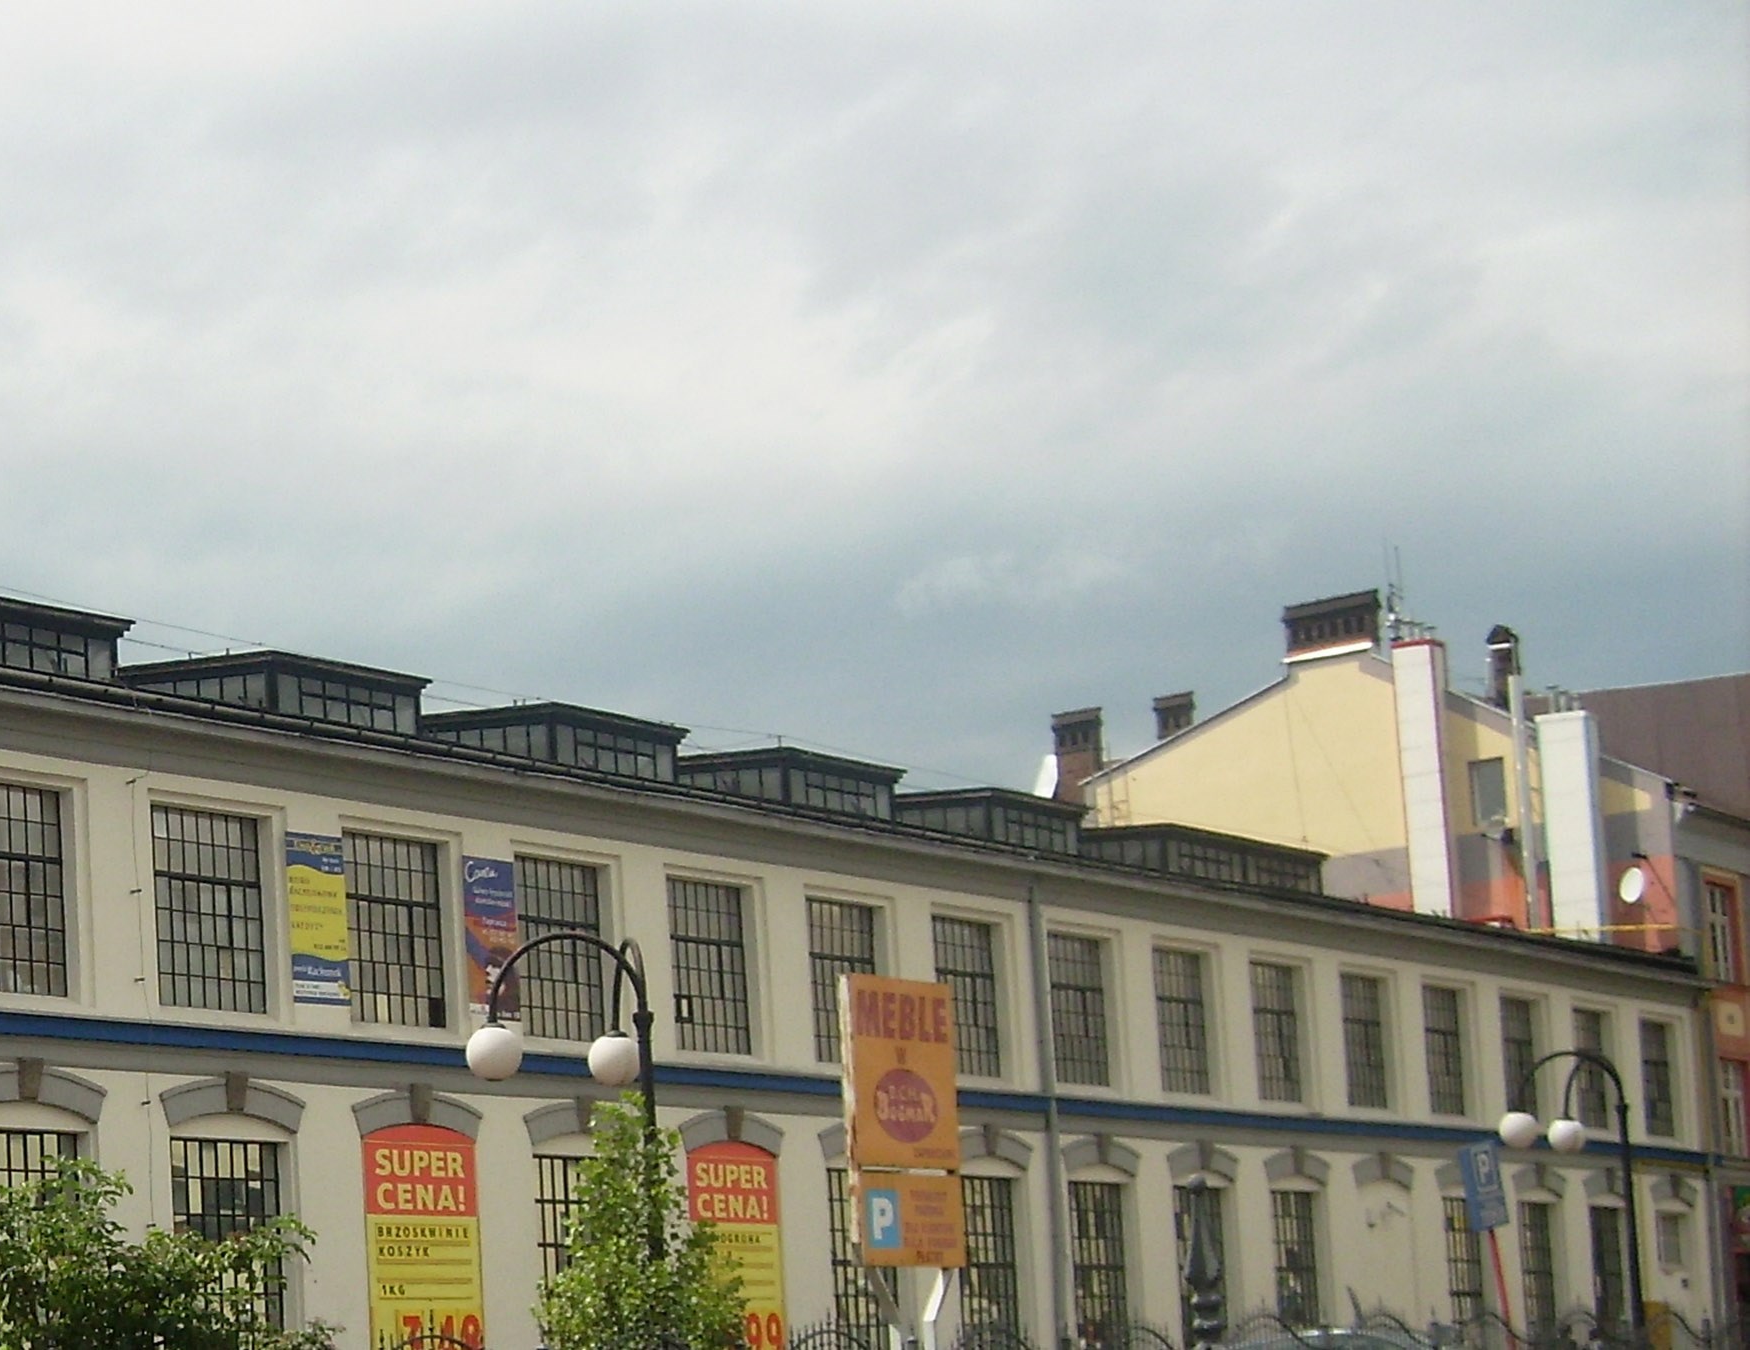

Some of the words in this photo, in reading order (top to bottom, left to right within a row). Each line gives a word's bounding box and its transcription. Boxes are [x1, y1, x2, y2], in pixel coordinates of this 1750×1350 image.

[856, 989, 948, 1043] MEBLE
[374, 1148, 465, 1178] SUPER
[695, 1162, 768, 1189] SUPER
[376, 1182, 466, 1212] CENA!
[696, 1193, 769, 1220] CENA!
[377, 1226, 469, 1239] BRZOSKWINIE
[872, 1198, 894, 1240] P
[378, 1245, 430, 1257] KOSZYK
